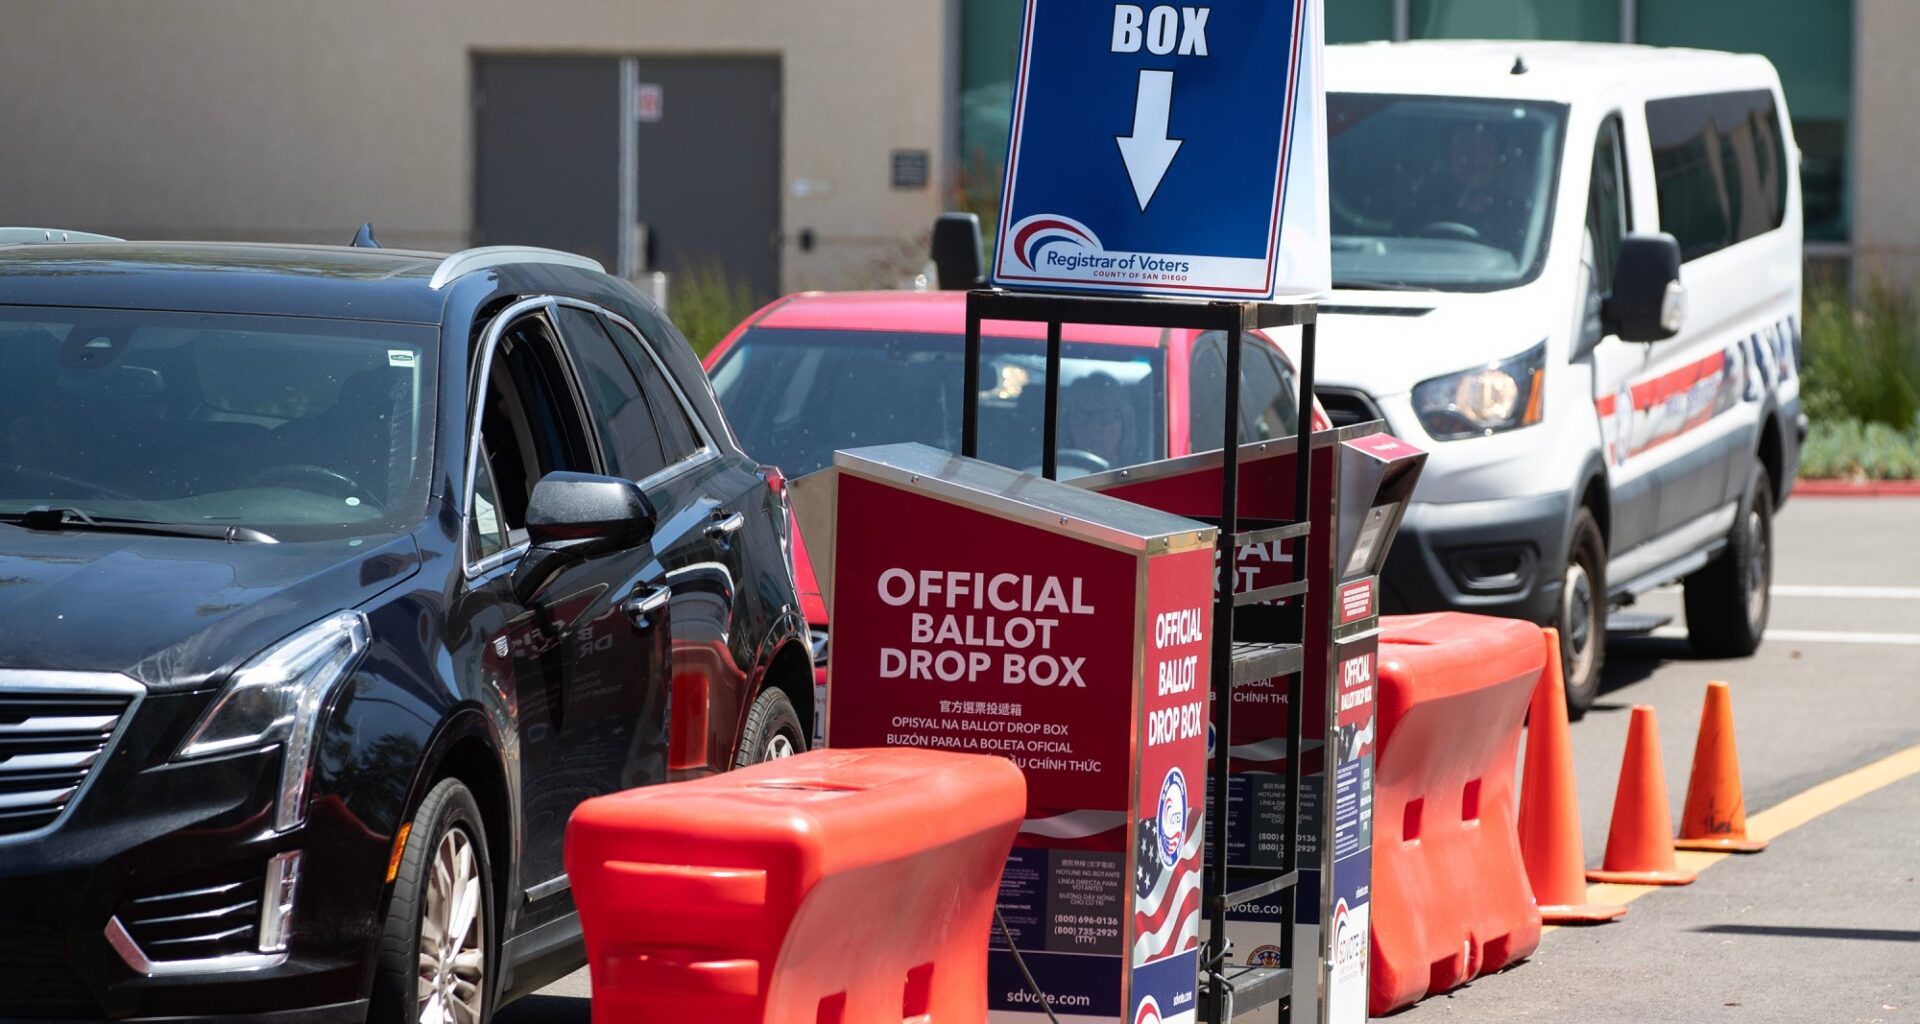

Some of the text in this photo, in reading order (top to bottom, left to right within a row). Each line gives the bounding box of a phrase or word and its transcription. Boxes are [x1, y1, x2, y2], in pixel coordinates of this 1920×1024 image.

[1111, 4, 1211, 57] BOX
[1047, 251, 1190, 273] Registrar of Voters
[1093, 270, 1189, 282] COUNTY OF SAN DIEGO
[877, 567, 1095, 615] OFFICIAL
[911, 613, 1060, 650] BALLOT
[1155, 607, 1203, 649] OFFICIAL
[879, 648, 1087, 688] DROP BOX
[1158, 655, 1198, 697] BALLOT
[1344, 655, 1370, 688] OFFICIAL
[1233, 691, 1269, 704] CHÍNH
[892, 716, 1069, 736] OPISYAL NA BALLOT DROP BOX
[1148, 701, 1203, 747] DROP BOX
[886, 733, 1073, 753] BUZÓN PARA LA BOLETA OFICIAL
[1028, 756, 1067, 771] CHÍNH
[1068, 758, 1102, 773] THỨC
[1258, 832, 1279, 841] (800)
[1258, 843, 1279, 852] (800)
[1055, 915, 1118, 925] (800) 696-0136
[1054, 926, 1118, 937] (800) 735-2929
[1075, 936, 1096, 944] (TTY)
[1006, 989, 1090, 1006] sdvote.com
